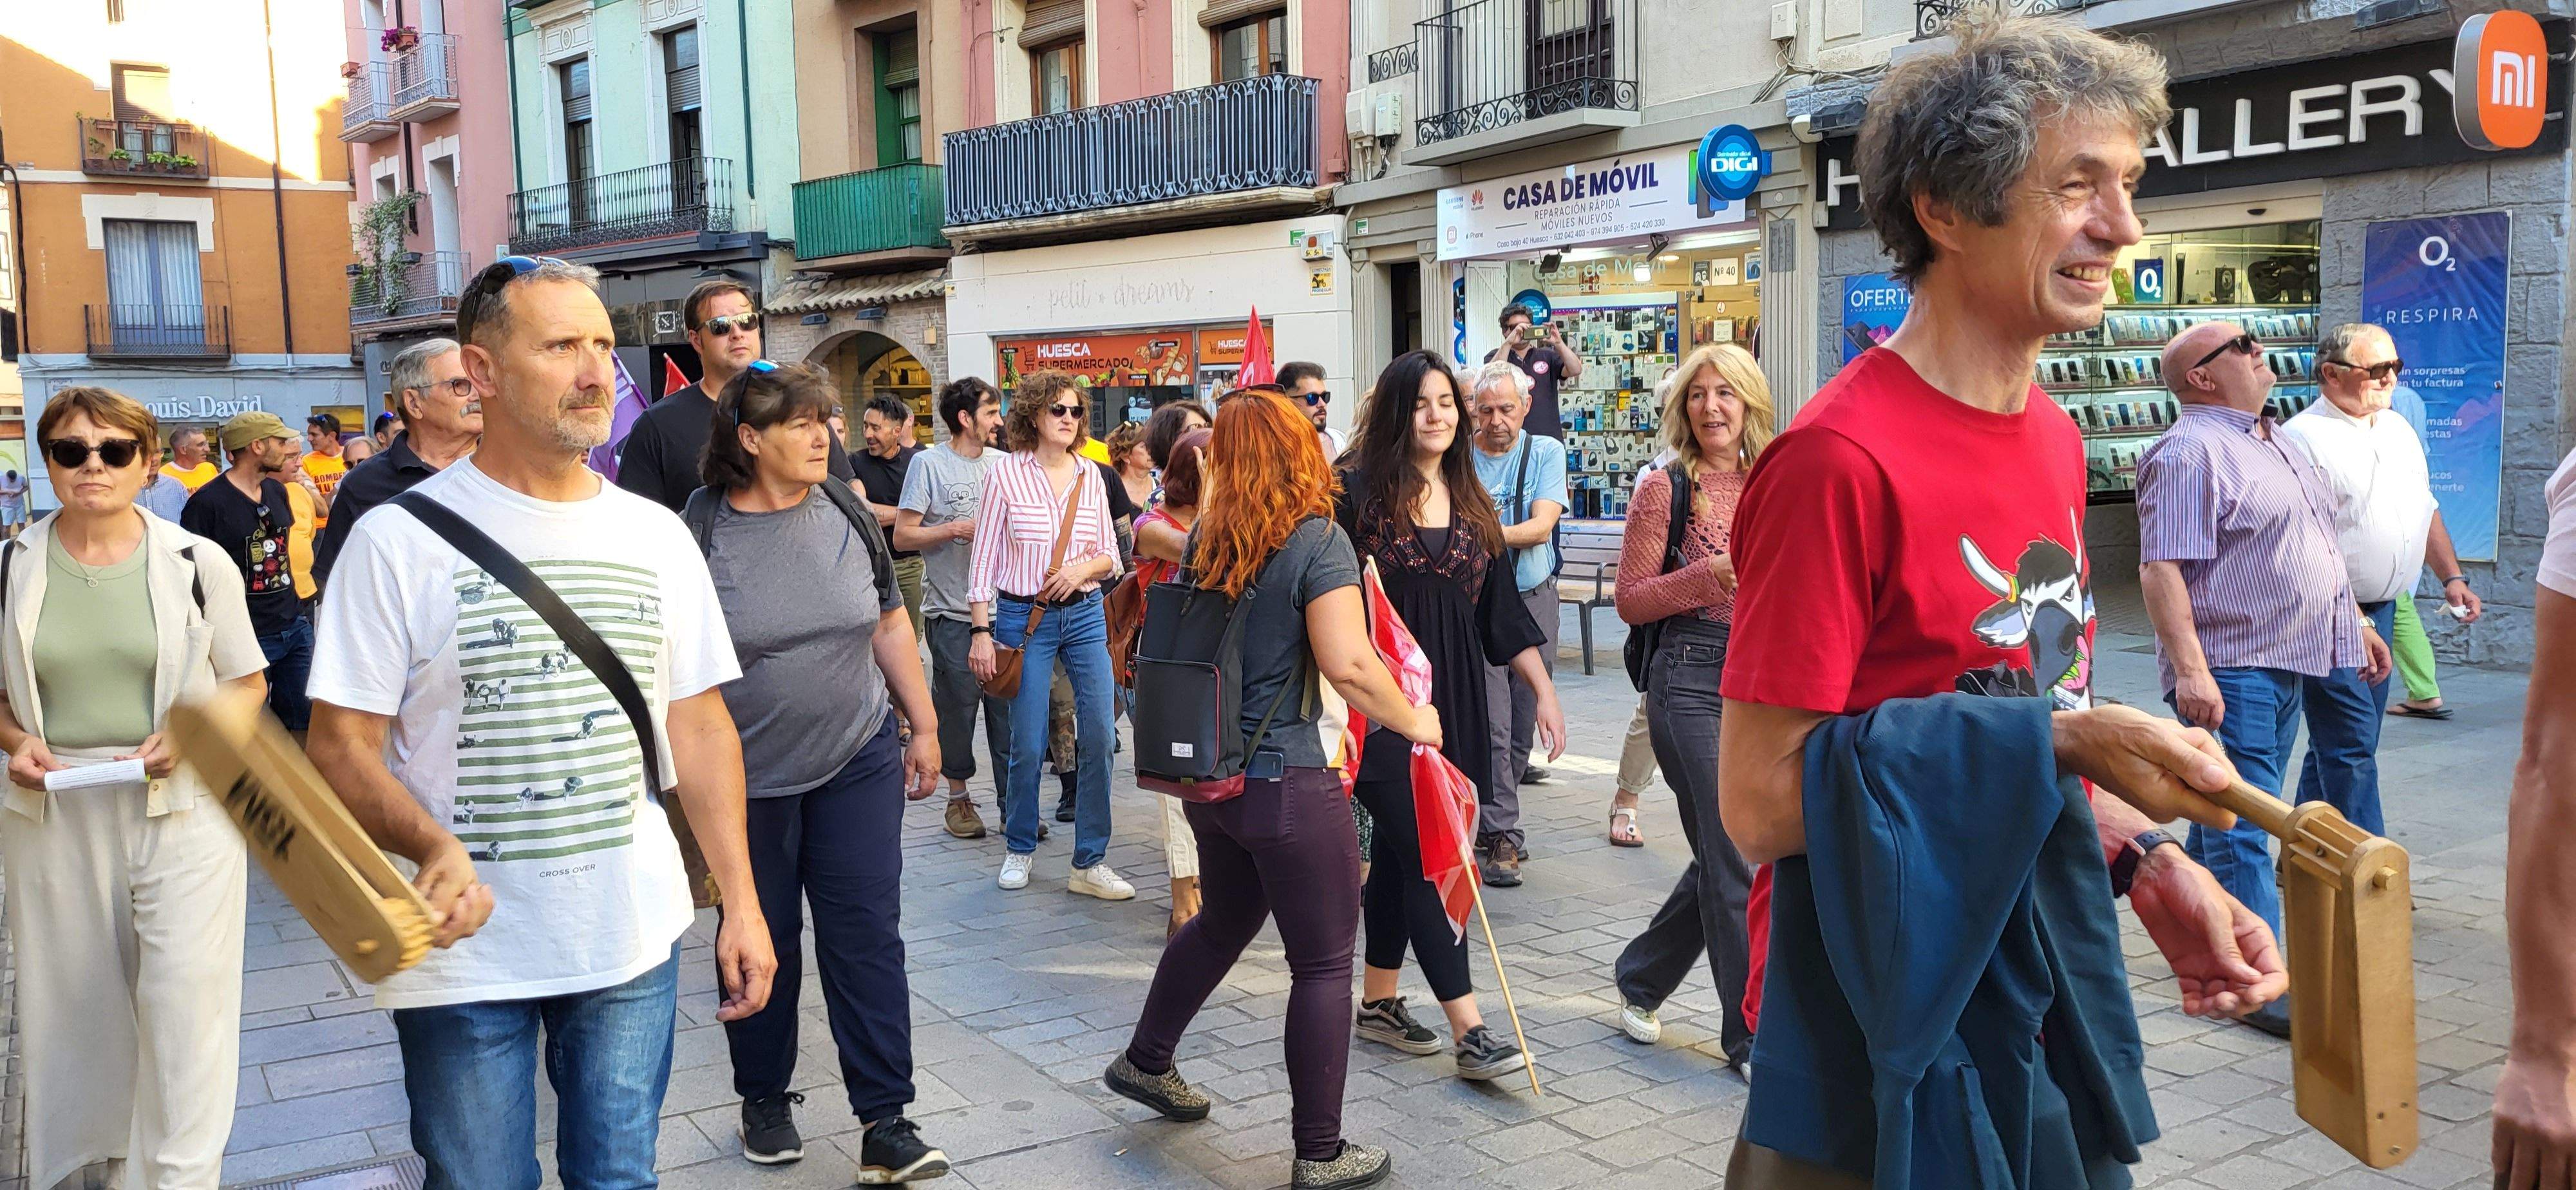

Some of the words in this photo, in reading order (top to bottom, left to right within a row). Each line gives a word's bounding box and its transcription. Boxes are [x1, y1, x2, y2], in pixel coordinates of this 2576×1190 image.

[1710, 156, 1758, 173] DIGI
[1503, 180, 1557, 211] CASA
[1560, 174, 1586, 202] DE
[1589, 158, 1659, 197] MÓVIL
[1534, 200, 1587, 221] REPARACIÓN
[1589, 196, 1621, 214] RÁPIDA
[1540, 215, 1576, 232] MÓVILES
[1578, 211, 1613, 227] NUEVOS
[1575, 229, 1586, 238] 403
[1642, 220, 1653, 229] 420
[1654, 218, 1665, 227] 330
[1583, 259, 1607, 277] de
[1726, 266, 1736, 276] 40
[2386, 306, 2479, 325] RESPIRA
[1037, 342, 1091, 358] HUESCA
[1038, 357, 1129, 371] SUPERMERCADO
[2414, 366, 2466, 377] sorpresas
[2424, 378, 2464, 388] factura
[197, 395, 262, 419] David
[539, 868, 570, 878] CROSS
[572, 864, 596, 873] OVER
